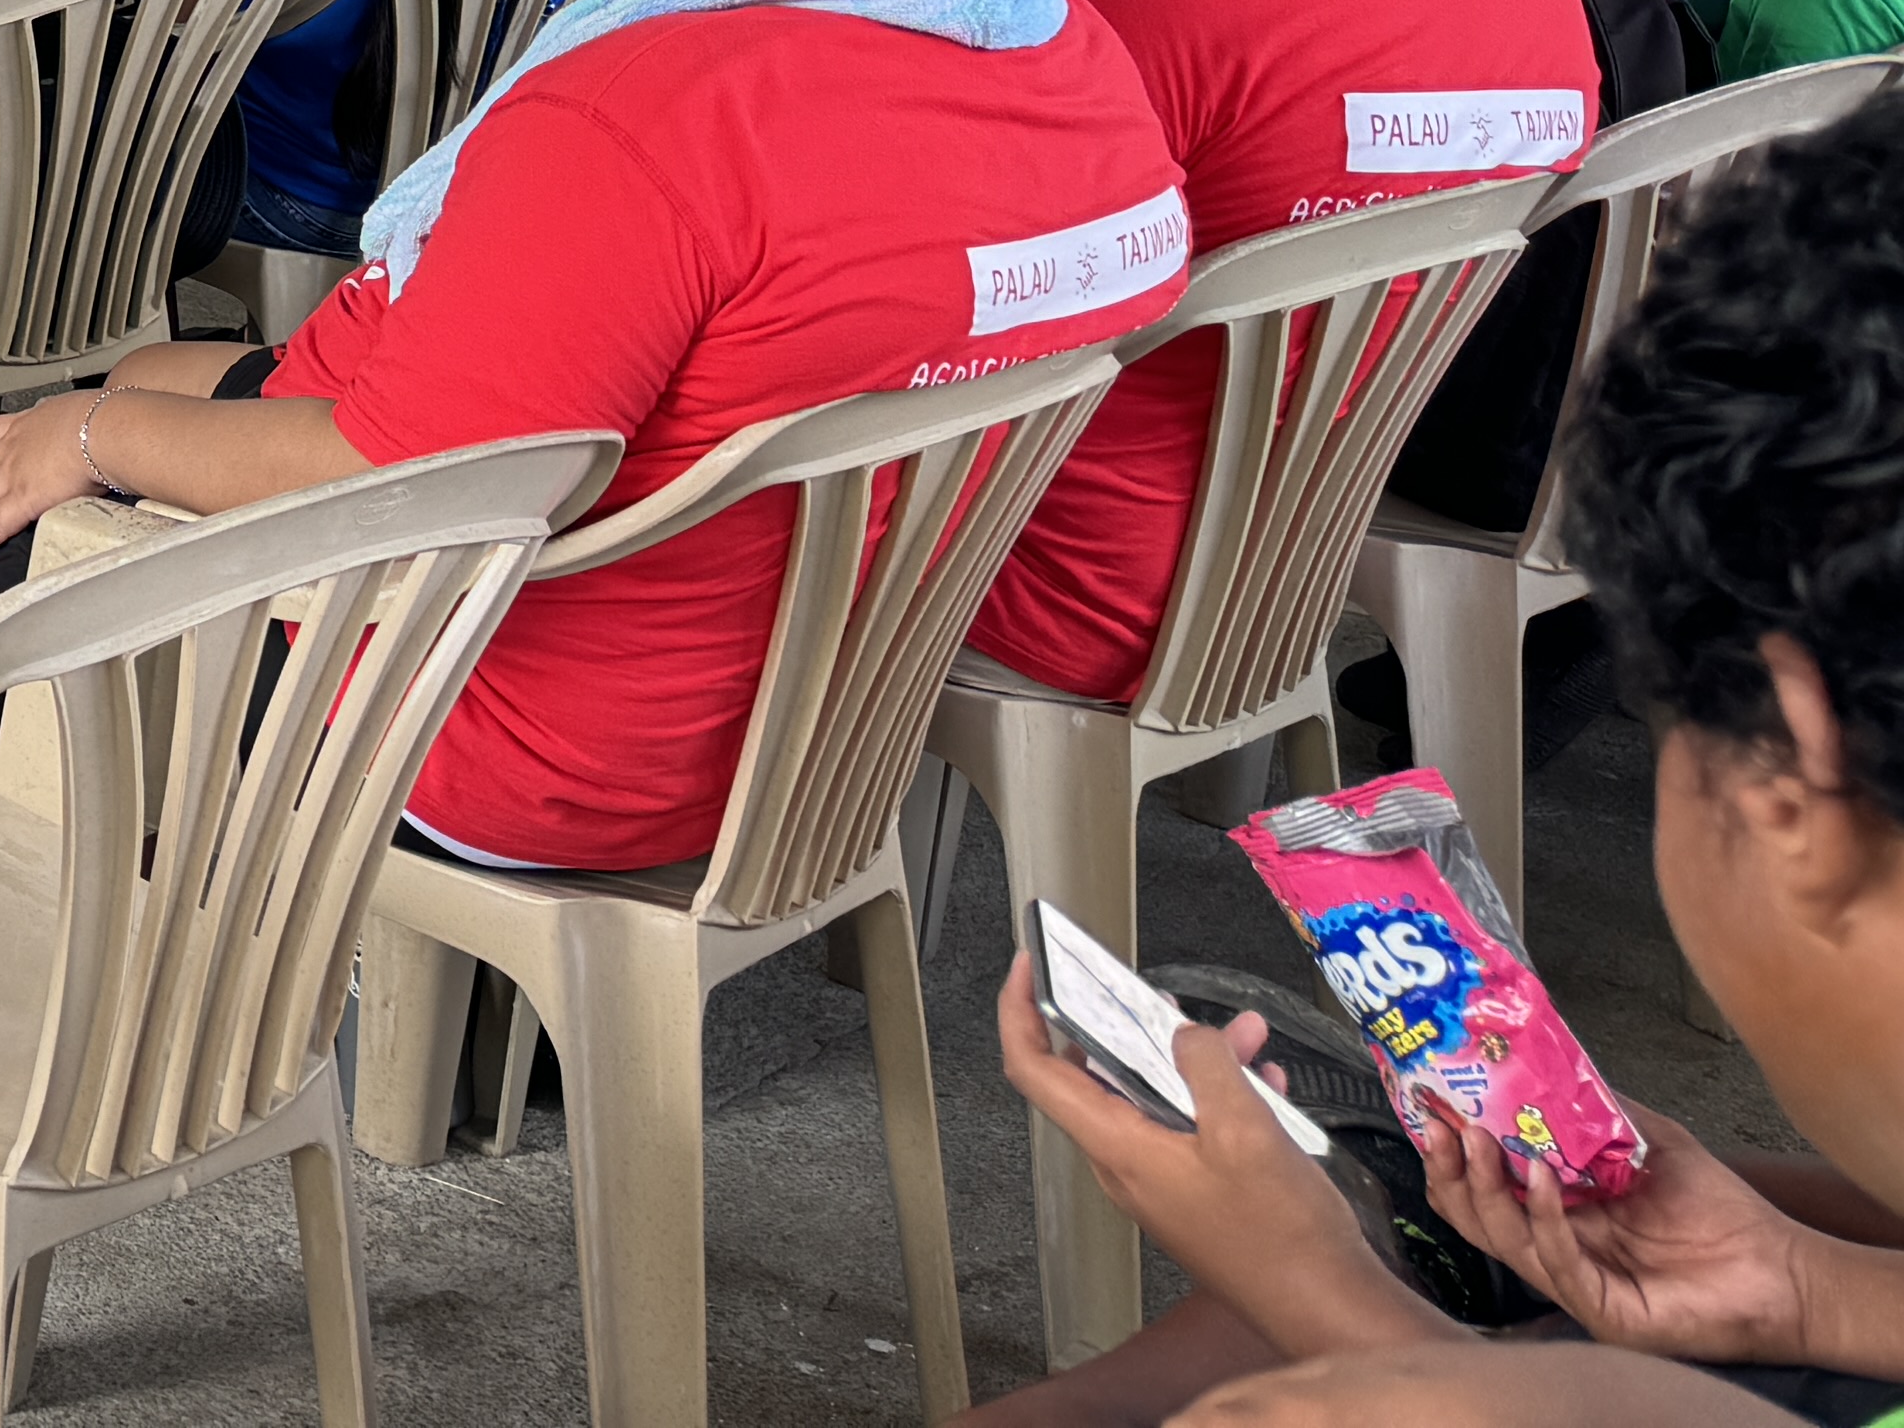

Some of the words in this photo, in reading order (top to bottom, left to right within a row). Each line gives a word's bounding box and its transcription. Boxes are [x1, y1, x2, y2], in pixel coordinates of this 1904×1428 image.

[1369, 112, 1450, 147] PALAU
[1510, 109, 1579, 143] TAIWAN
[992, 257, 1057, 307] PALAU
[1115, 211, 1185, 272] TAIWAN
